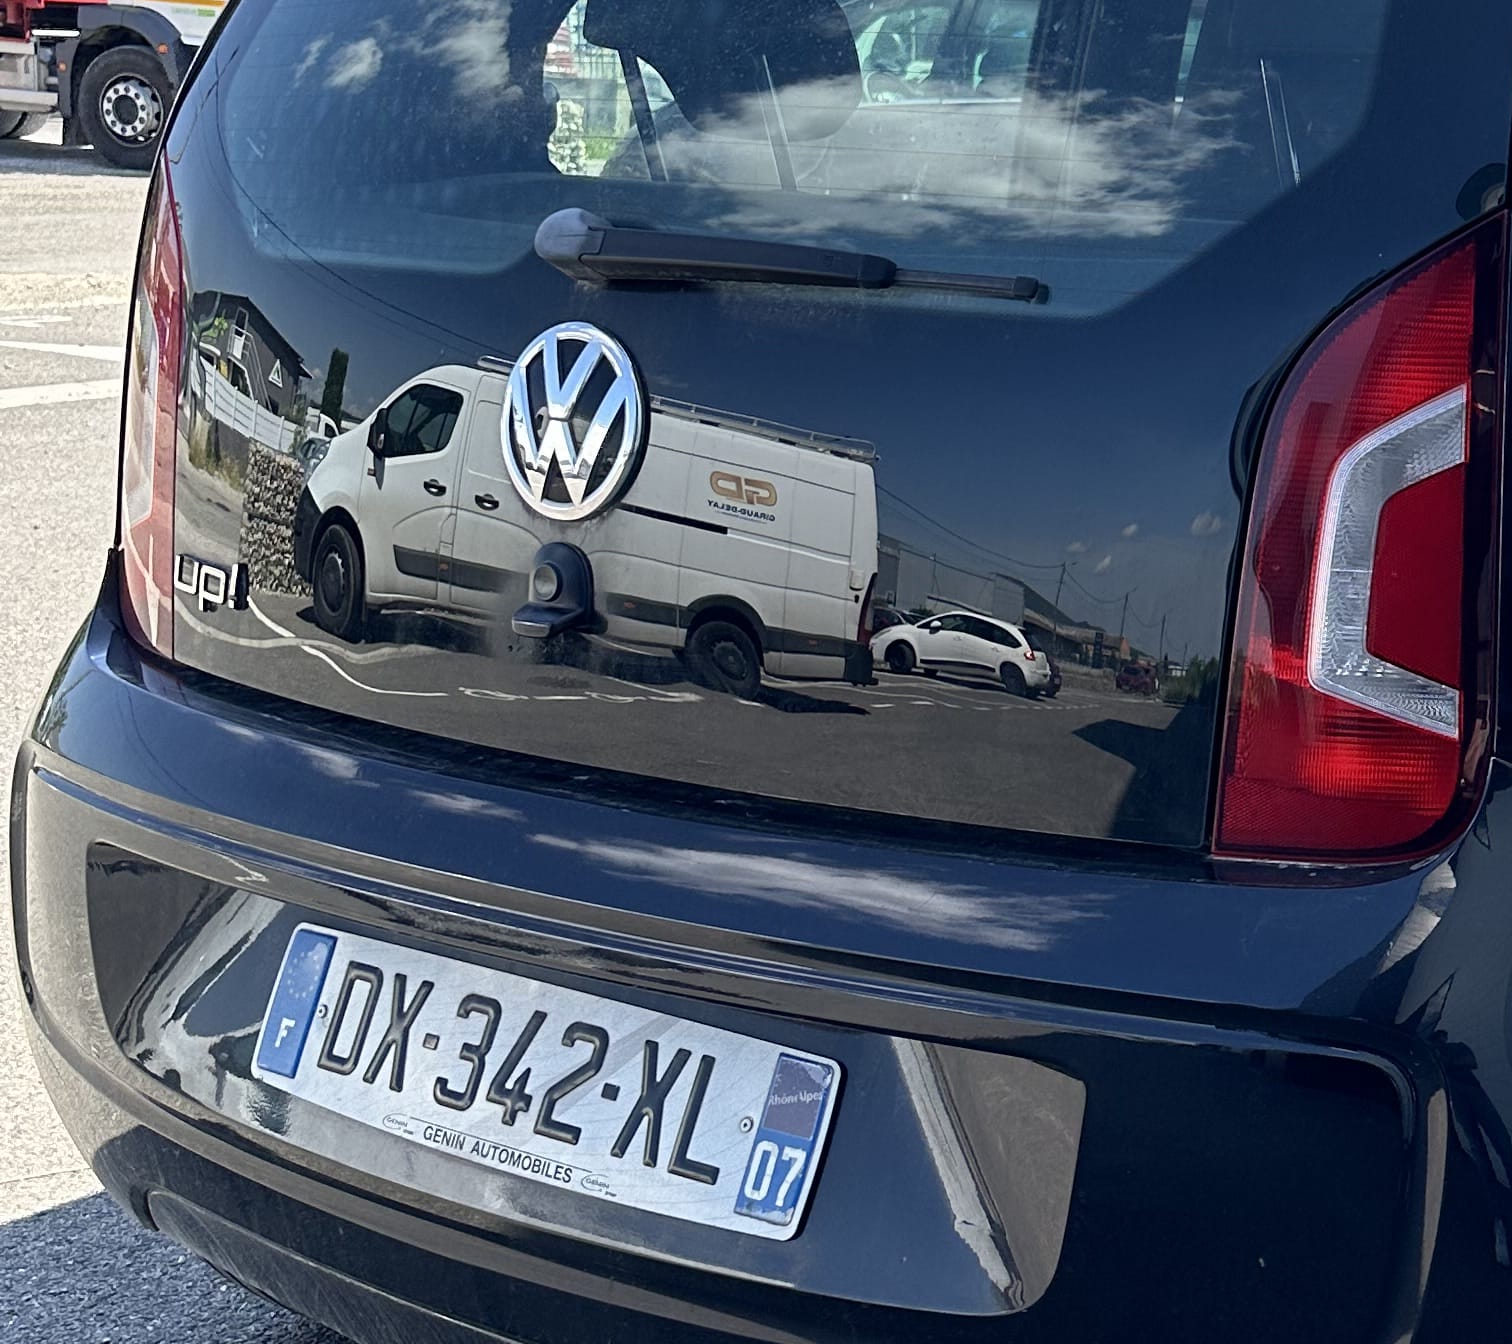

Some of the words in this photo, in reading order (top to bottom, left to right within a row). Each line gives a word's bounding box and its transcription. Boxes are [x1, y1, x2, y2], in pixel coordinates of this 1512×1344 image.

[174, 554, 239, 611] up!
[273, 1018, 296, 1049] F
[317, 960, 719, 1185] DX-342-XL
[423, 1125, 465, 1151] GENIN
[470, 1140, 573, 1183] AUTOMOBILES
[744, 1140, 806, 1207] 07
